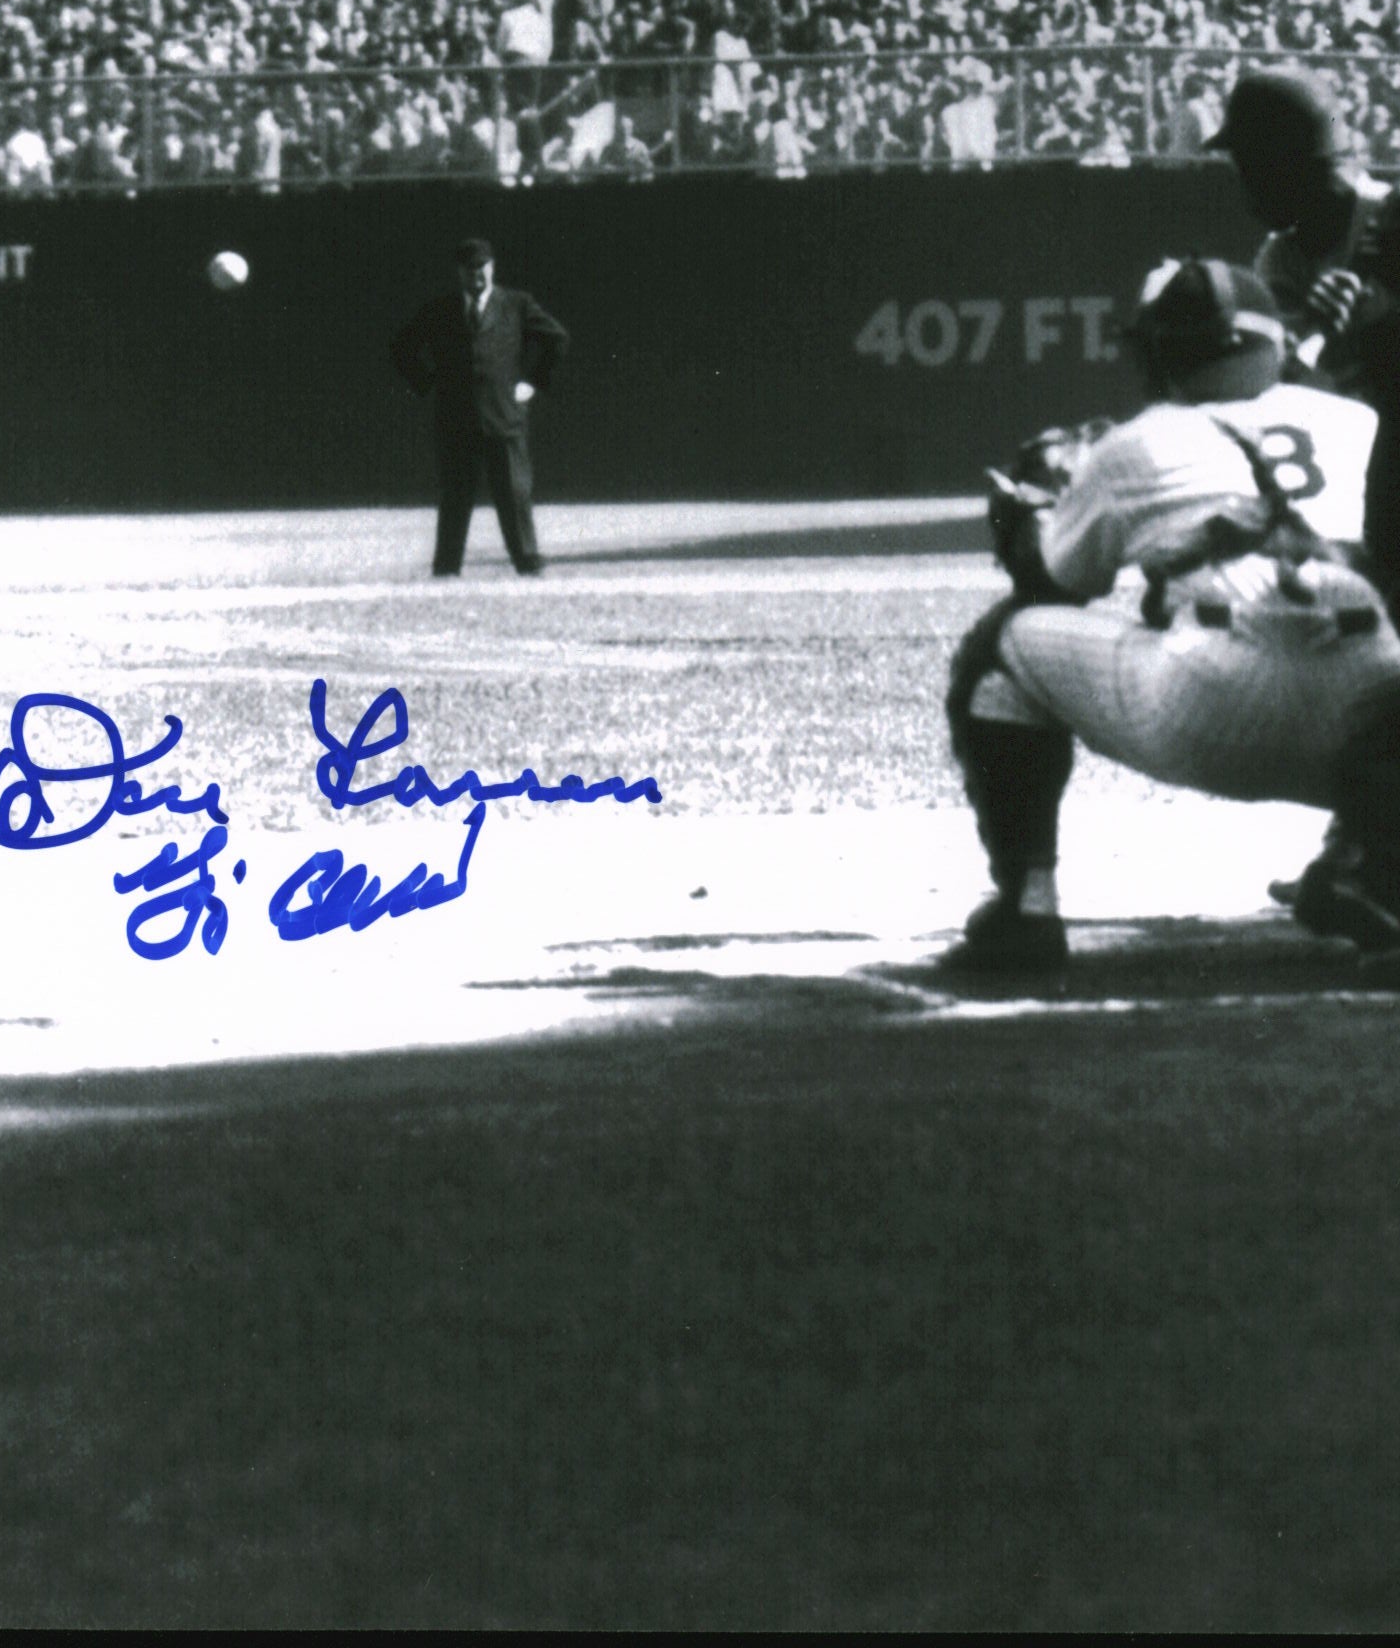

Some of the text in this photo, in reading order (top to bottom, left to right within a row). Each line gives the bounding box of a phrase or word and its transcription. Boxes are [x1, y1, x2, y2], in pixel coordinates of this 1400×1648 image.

[855, 295, 1120, 366] 407 FT.
[1255, 423, 1327, 500] 8
